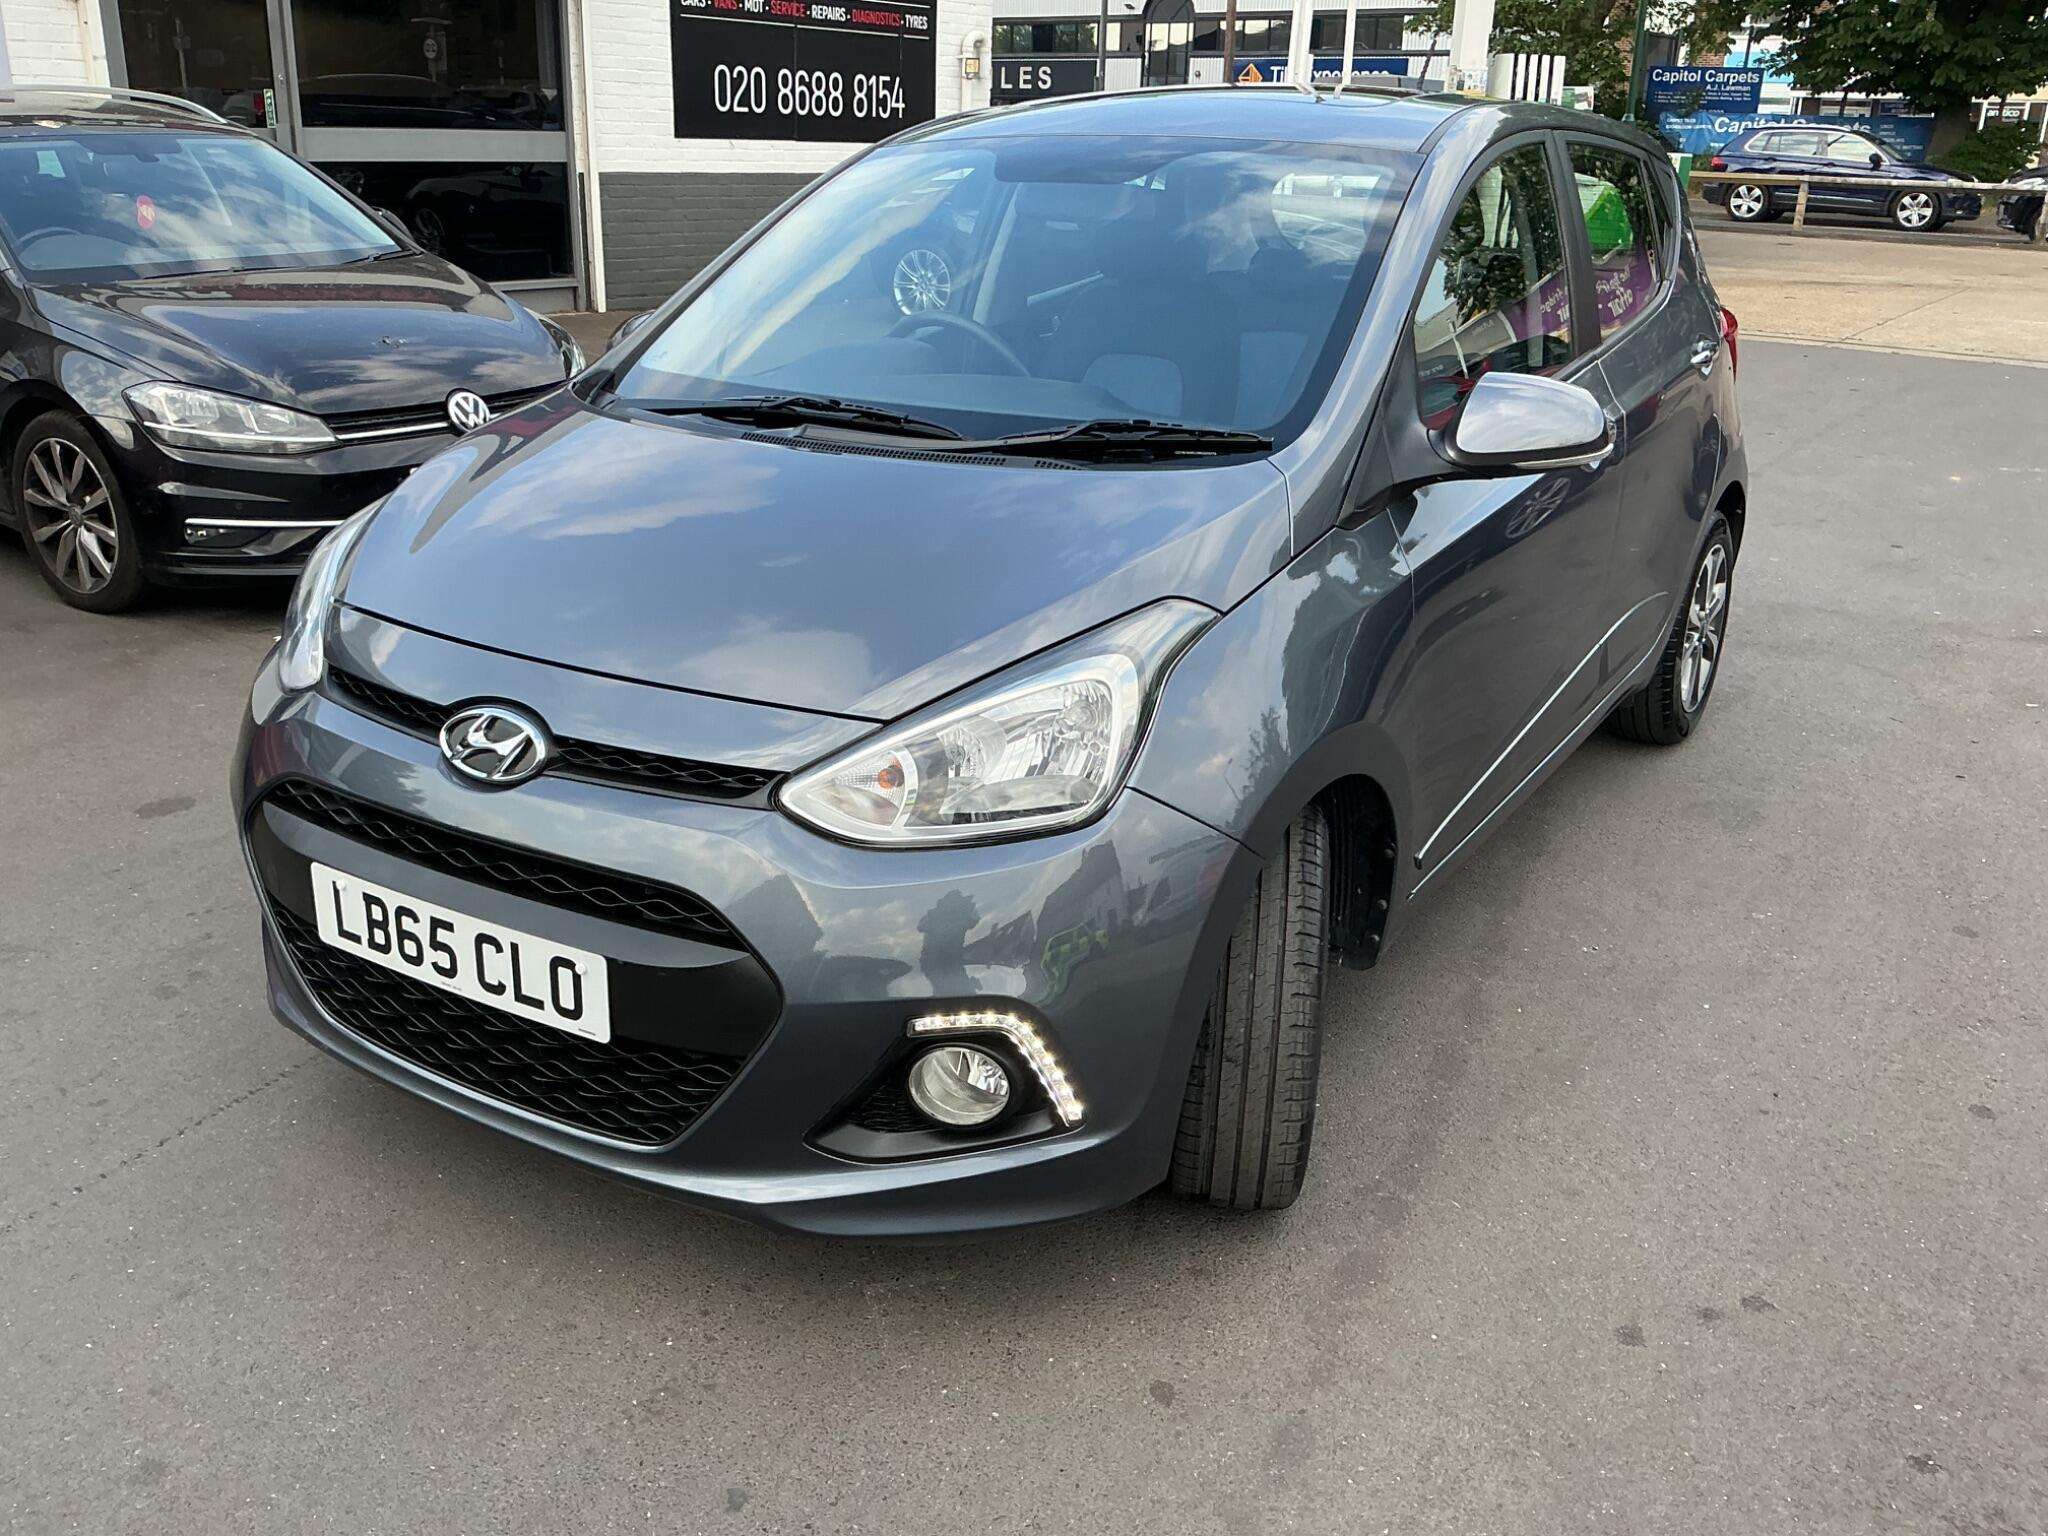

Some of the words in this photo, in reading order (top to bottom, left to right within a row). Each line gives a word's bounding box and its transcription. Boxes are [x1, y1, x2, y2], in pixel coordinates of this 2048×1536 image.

[744, 0, 764, 13] MOT
[770, 0, 806, 17] SERVICE
[811, 5, 846, 21] REPAIRS
[851, 9, 900, 26] DIAGNOSTICS
[904, 14, 928, 30] TYRES
[714, 64, 767, 114] 020
[777, 68, 843, 118] 8688
[853, 73, 906, 119] 8154
[1652, 69, 1701, 84] Capitol
[1705, 70, 1760, 85] Carpets
[332, 880, 458, 979] LB65
